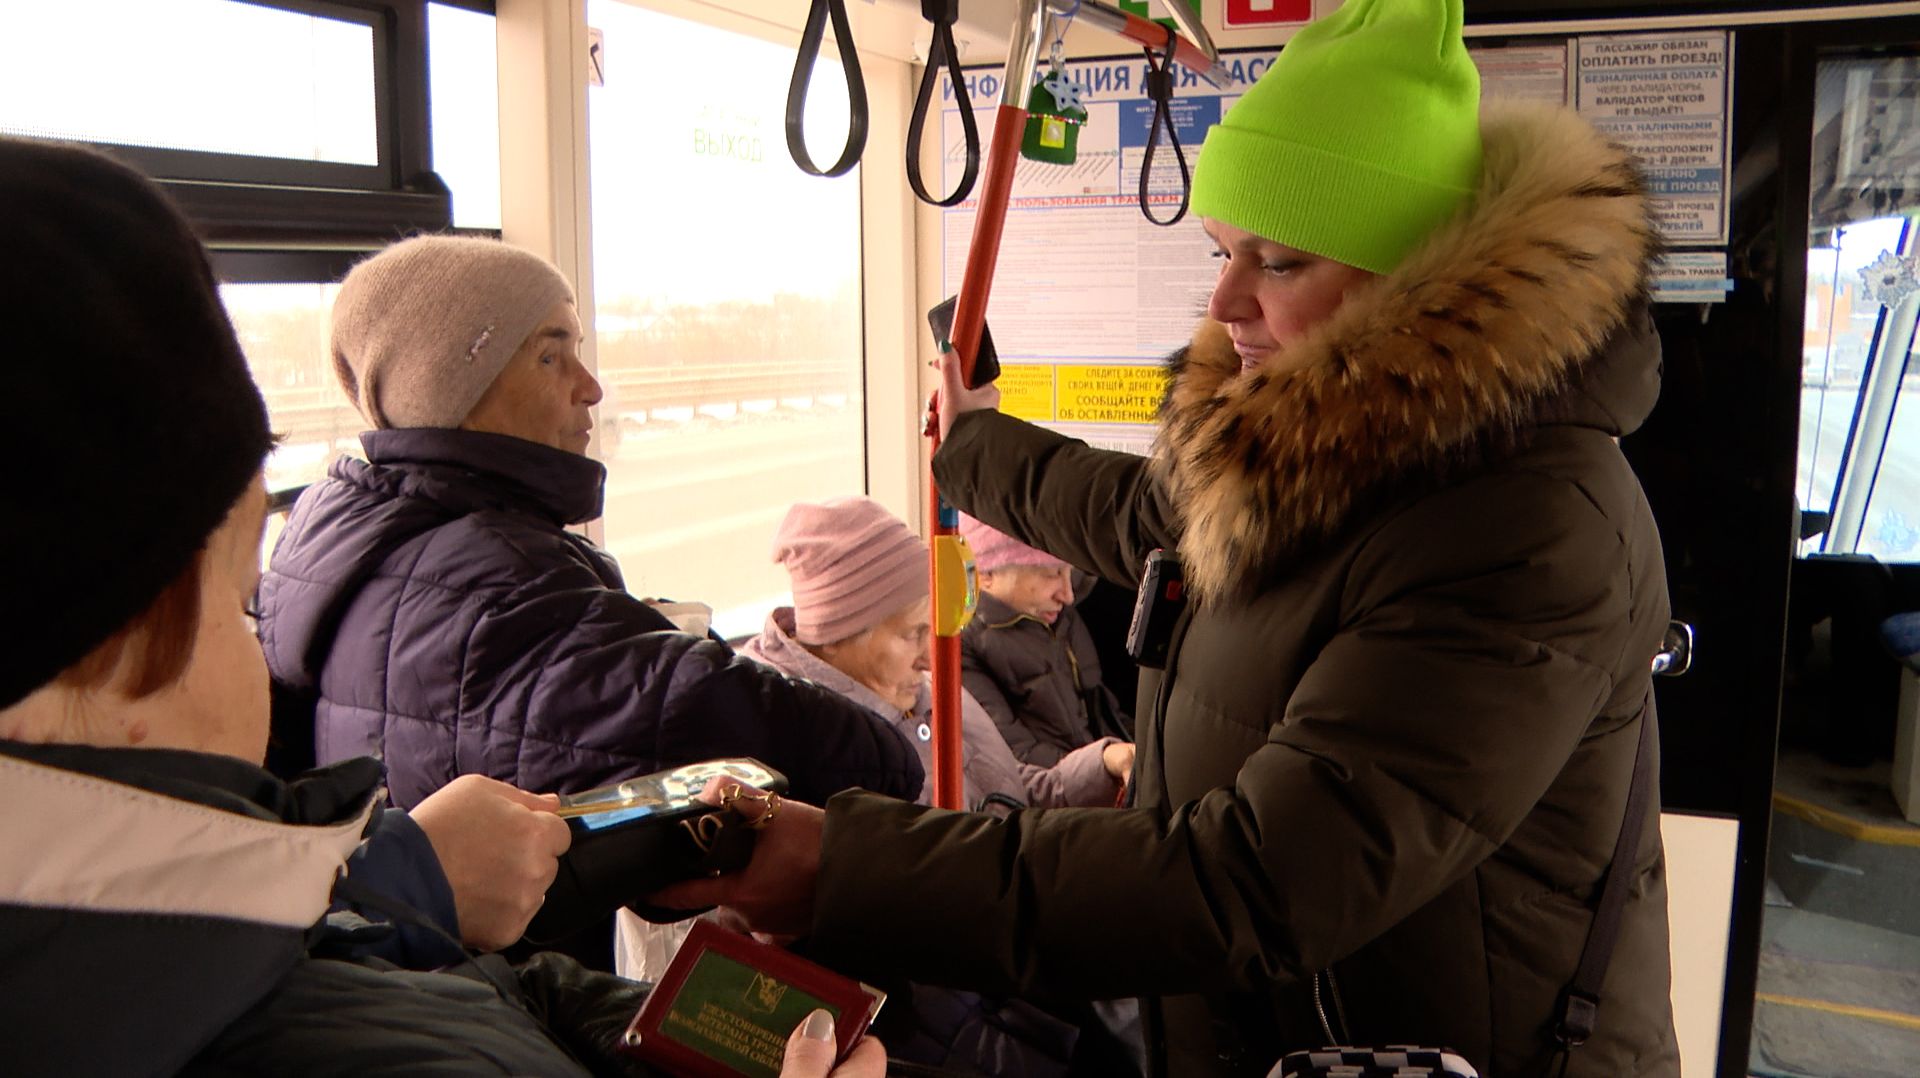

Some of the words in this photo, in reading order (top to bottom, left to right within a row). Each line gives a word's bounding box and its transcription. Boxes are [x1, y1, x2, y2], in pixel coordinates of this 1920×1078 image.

[1595, 42, 1658, 53] ПАССАЖИР
[1661, 40, 1708, 51] ОБЯЗАН
[1581, 55, 1656, 68] ОПЛАТИТЬ
[1660, 52, 1722, 65] ПРОЕЗД!
[943, 66, 1130, 101] ИНФЦИЯ
[1584, 72, 1667, 83] БЕЗНАЛИЧНАЯ
[1671, 70, 1718, 80] ОПЛАТА
[1596, 95, 1664, 106] ВАЛИДАТОР
[1667, 94, 1705, 104] ЧЕКОВ
[1597, 123, 1632, 133] ПЛАТА
[694, 127, 763, 163] ВЫХОД
[703, 1001, 786, 1046] УДОСТОВЕРЕНИ
